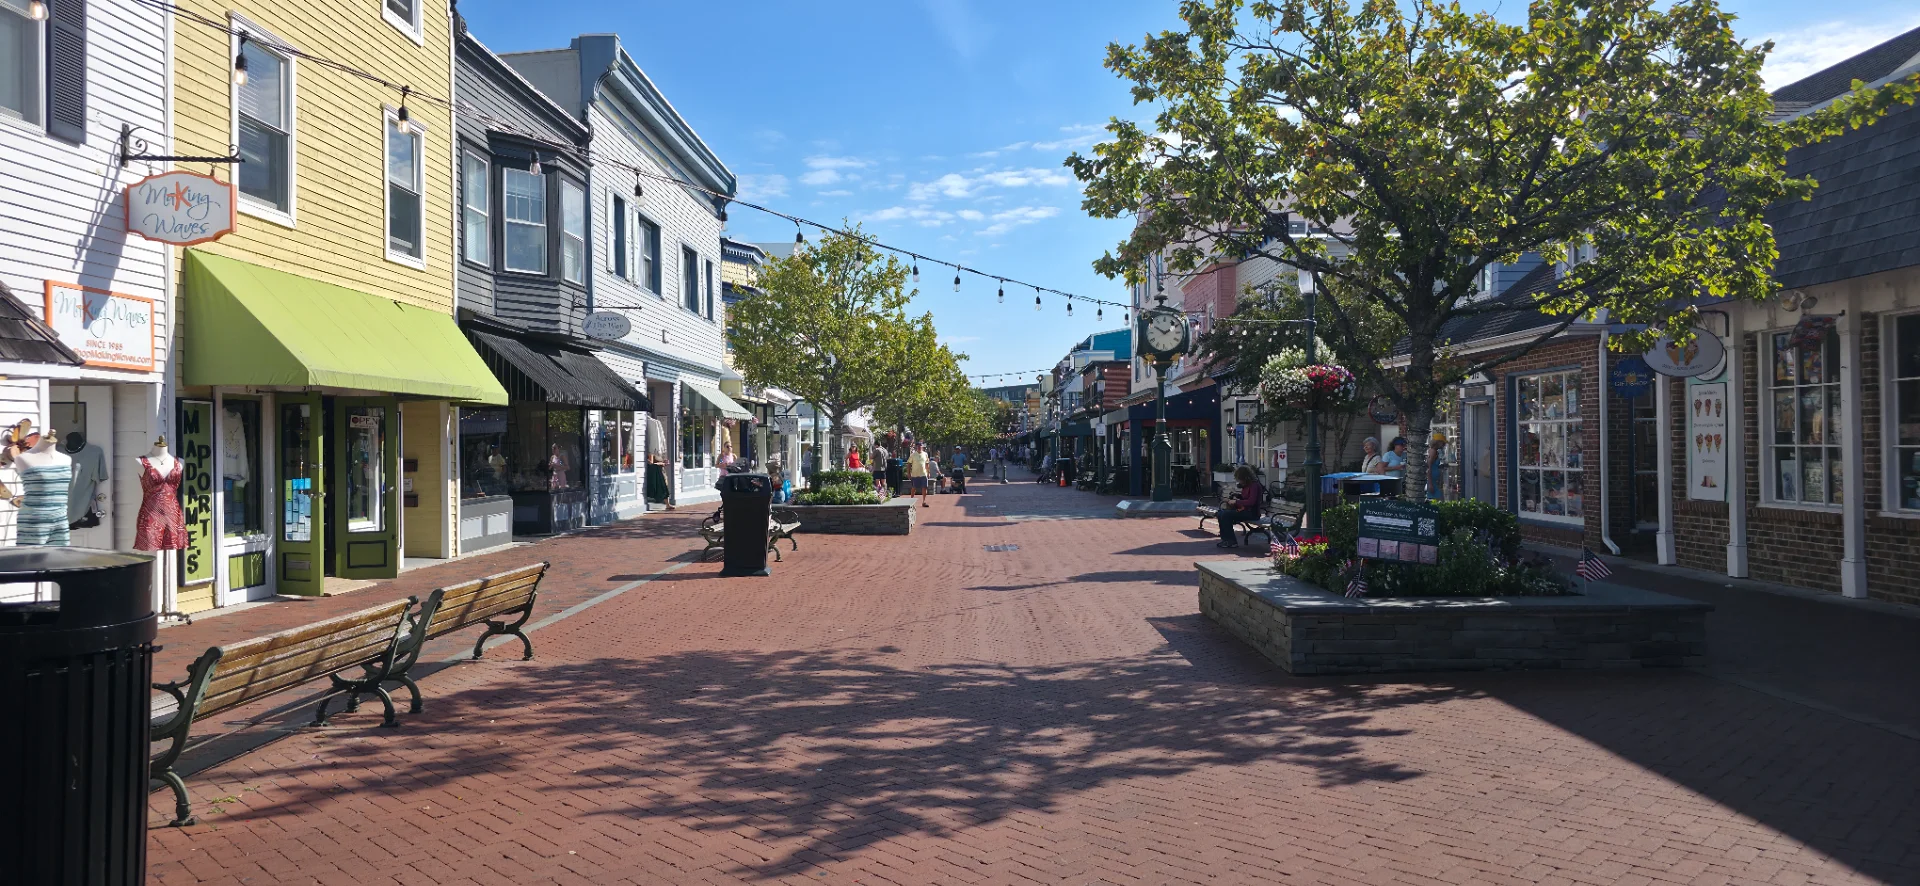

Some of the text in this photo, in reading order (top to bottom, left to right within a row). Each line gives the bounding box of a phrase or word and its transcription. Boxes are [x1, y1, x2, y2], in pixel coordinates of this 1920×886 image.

[143, 213, 209, 239] Waves
[110, 298, 149, 328] Waves
[86, 339, 124, 350] SINCE 1985
[351, 416, 378, 426] OPEN
[183, 410, 202, 574] MADAME'S
[197, 445, 211, 538] PORT
